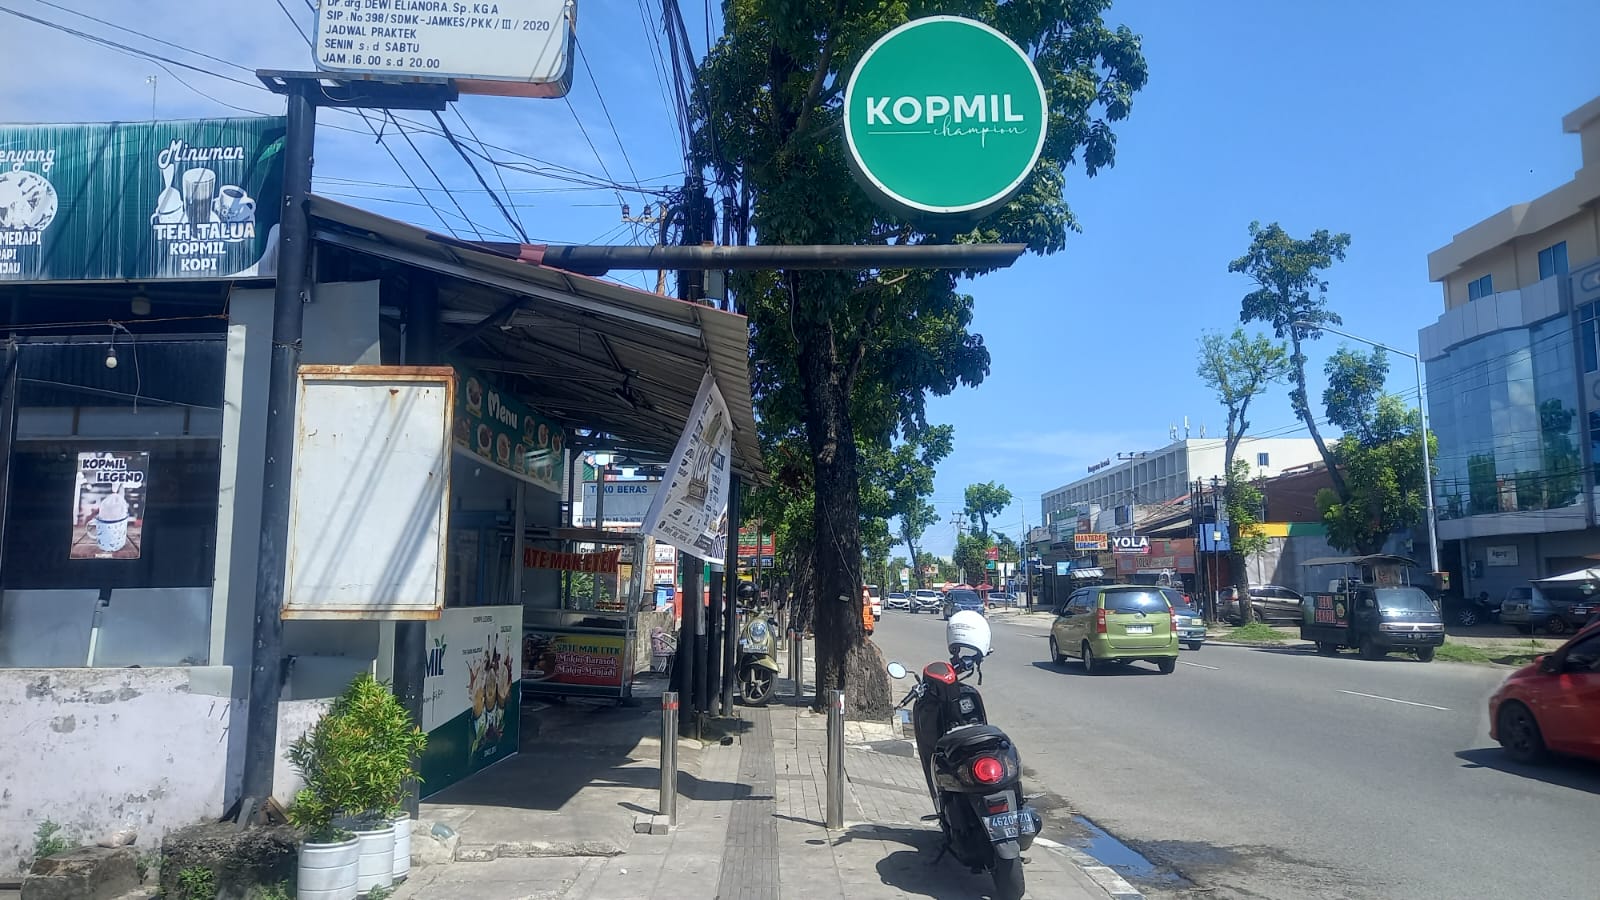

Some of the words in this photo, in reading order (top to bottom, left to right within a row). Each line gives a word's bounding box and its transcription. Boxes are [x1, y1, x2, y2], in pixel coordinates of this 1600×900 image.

[325, 24, 367, 36] JADWAL
[371, 27, 417, 39] PRAKTEK
[324, 38, 353, 50] SENIN
[385, 42, 420, 53] SABTU
[409, 58, 439, 69] 20.00
[866, 94, 1024, 125] KOPMIL
[933, 115, 1027, 149] champion
[157, 139, 245, 169] Minuman
[153, 223, 190, 240] TEH
[197, 221, 255, 240] TALUA
[0, 248, 17, 260] API
[169, 241, 227, 255] KOPMIL
[180, 257, 217, 272] KOPI
[487, 389, 518, 430] Menu
[82, 459, 127, 470] KOPMIL
[97, 473, 143, 483] LEGEND
[591, 485, 614, 494] TKO
[617, 485, 648, 494] BERAS
[1113, 536, 1148, 548] YOLA
